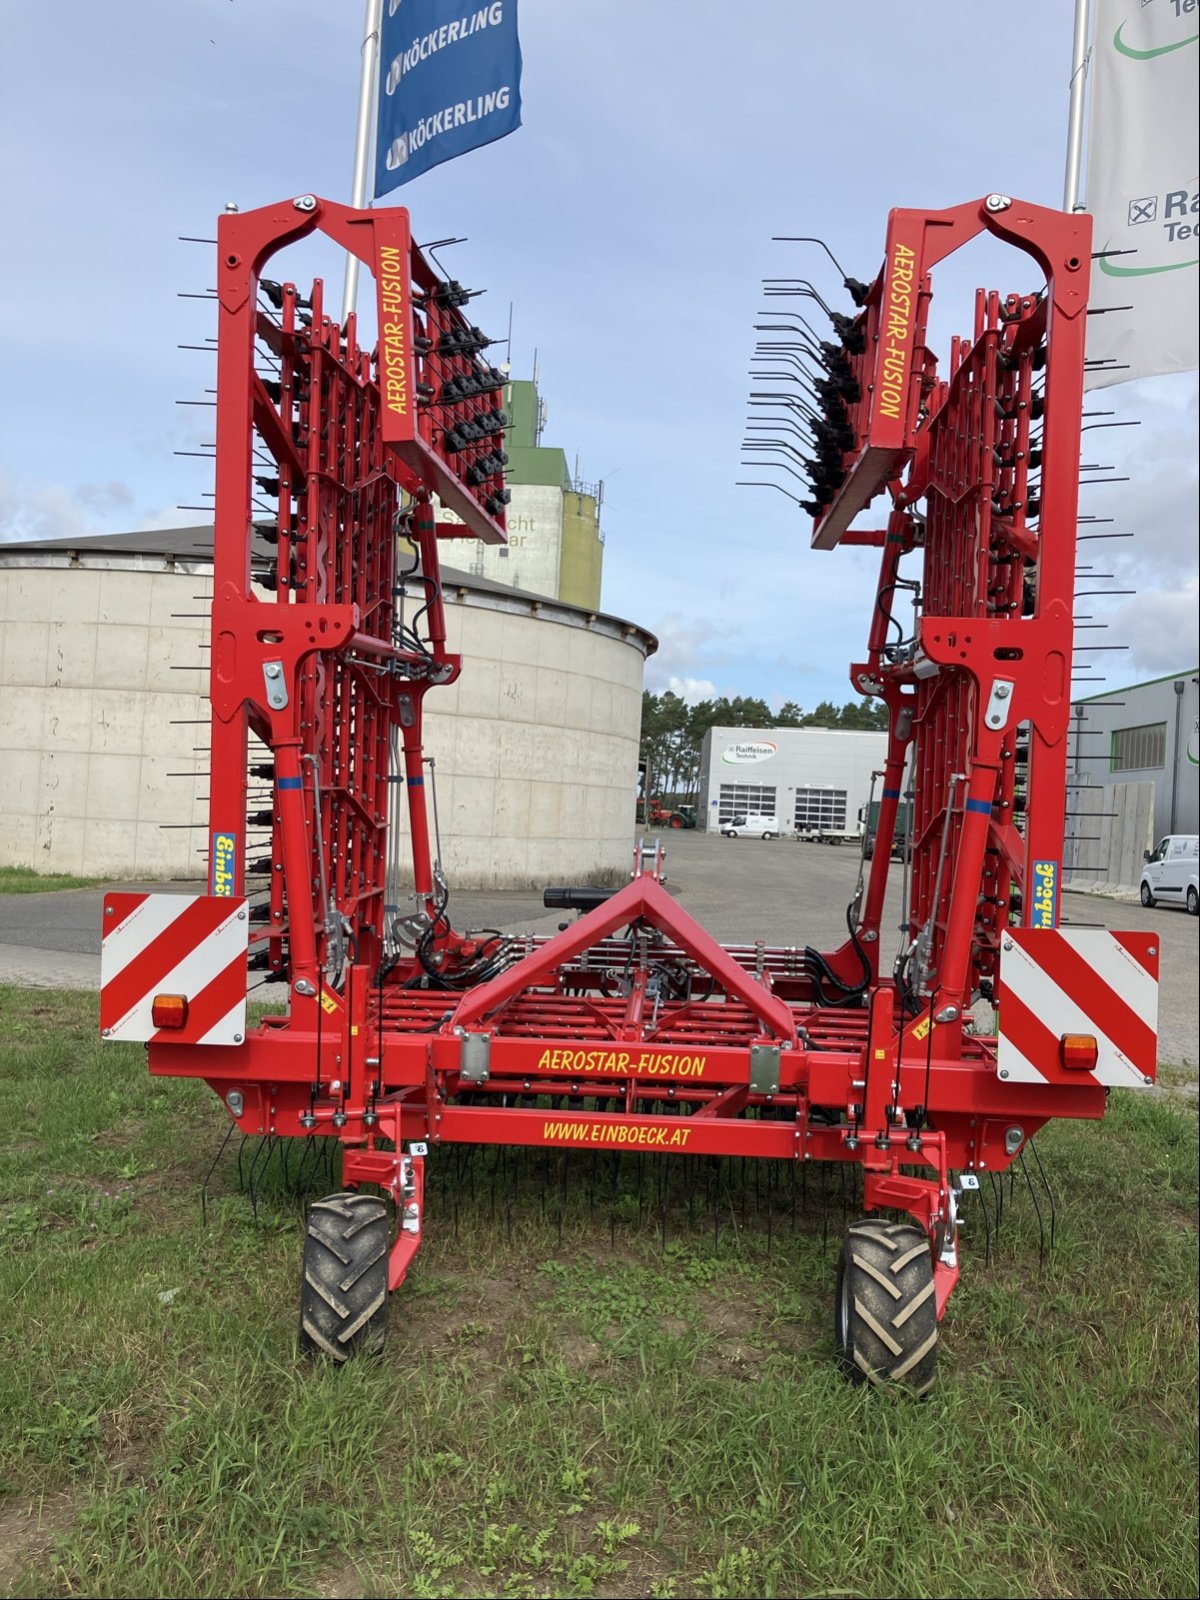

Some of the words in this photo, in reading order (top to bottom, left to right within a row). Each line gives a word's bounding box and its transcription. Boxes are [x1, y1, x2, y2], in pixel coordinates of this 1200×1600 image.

[402, 2, 503, 75] KÖCKERLING
[1170, 0, 1199, 17] Te
[408, 86, 510, 154] KÖCKERLING
[380, 246, 407, 415] AEROSTAR-FUSION
[880, 243, 916, 419] AEROSTAR-FUSION
[735, 745, 773, 754] Raiffeisen
[215, 835, 234, 896] Einbö
[538, 1049, 706, 1077] AEROSTAR-FUSION
[543, 1122, 691, 1146] WWW.EINBOECK.AT
